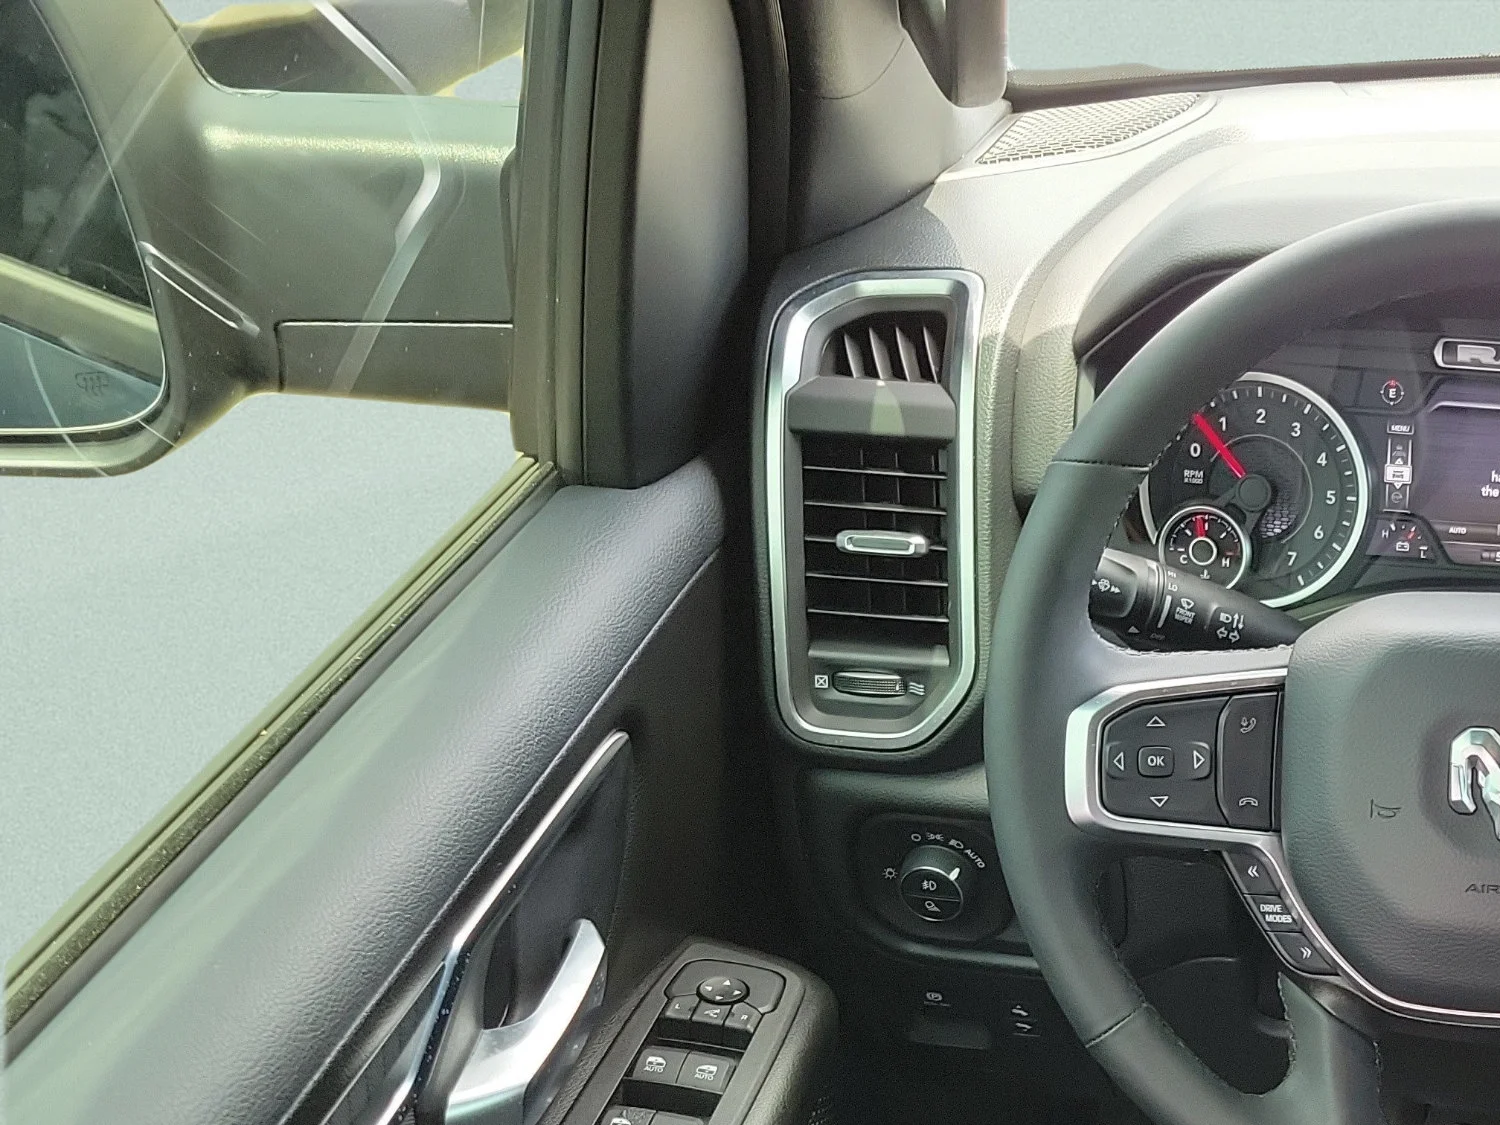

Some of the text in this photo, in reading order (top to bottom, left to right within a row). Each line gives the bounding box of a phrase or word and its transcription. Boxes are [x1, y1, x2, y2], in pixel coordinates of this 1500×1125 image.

[1388, 388, 1397, 399] E
[1256, 409, 1266, 424] 2
[1218, 417, 1227, 431] 1
[1291, 423, 1301, 438] 3
[1190, 443, 1201, 458] 0
[1316, 452, 1328, 467] 4
[1183, 469, 1204, 479] RPM
[1481, 486, 1500, 497] the
[1326, 490, 1336, 505] 5
[1314, 525, 1324, 539] 6
[1382, 530, 1389, 539] H
[1449, 527, 1467, 535] AUTO
[1180, 554, 1188, 564] C
[1222, 557, 1231, 568] H
[1287, 552, 1298, 566] 7
[1167, 582, 1178, 592] LO
[1175, 606, 1196, 619] FRONT
[1147, 755, 1165, 767] OK
[964, 847, 985, 869] AUTO
[1260, 904, 1282, 913] DRIVE
[1265, 914, 1293, 924] MODES
[644, 1065, 664, 1073] AUTO
[694, 1073, 714, 1081] AUTO
